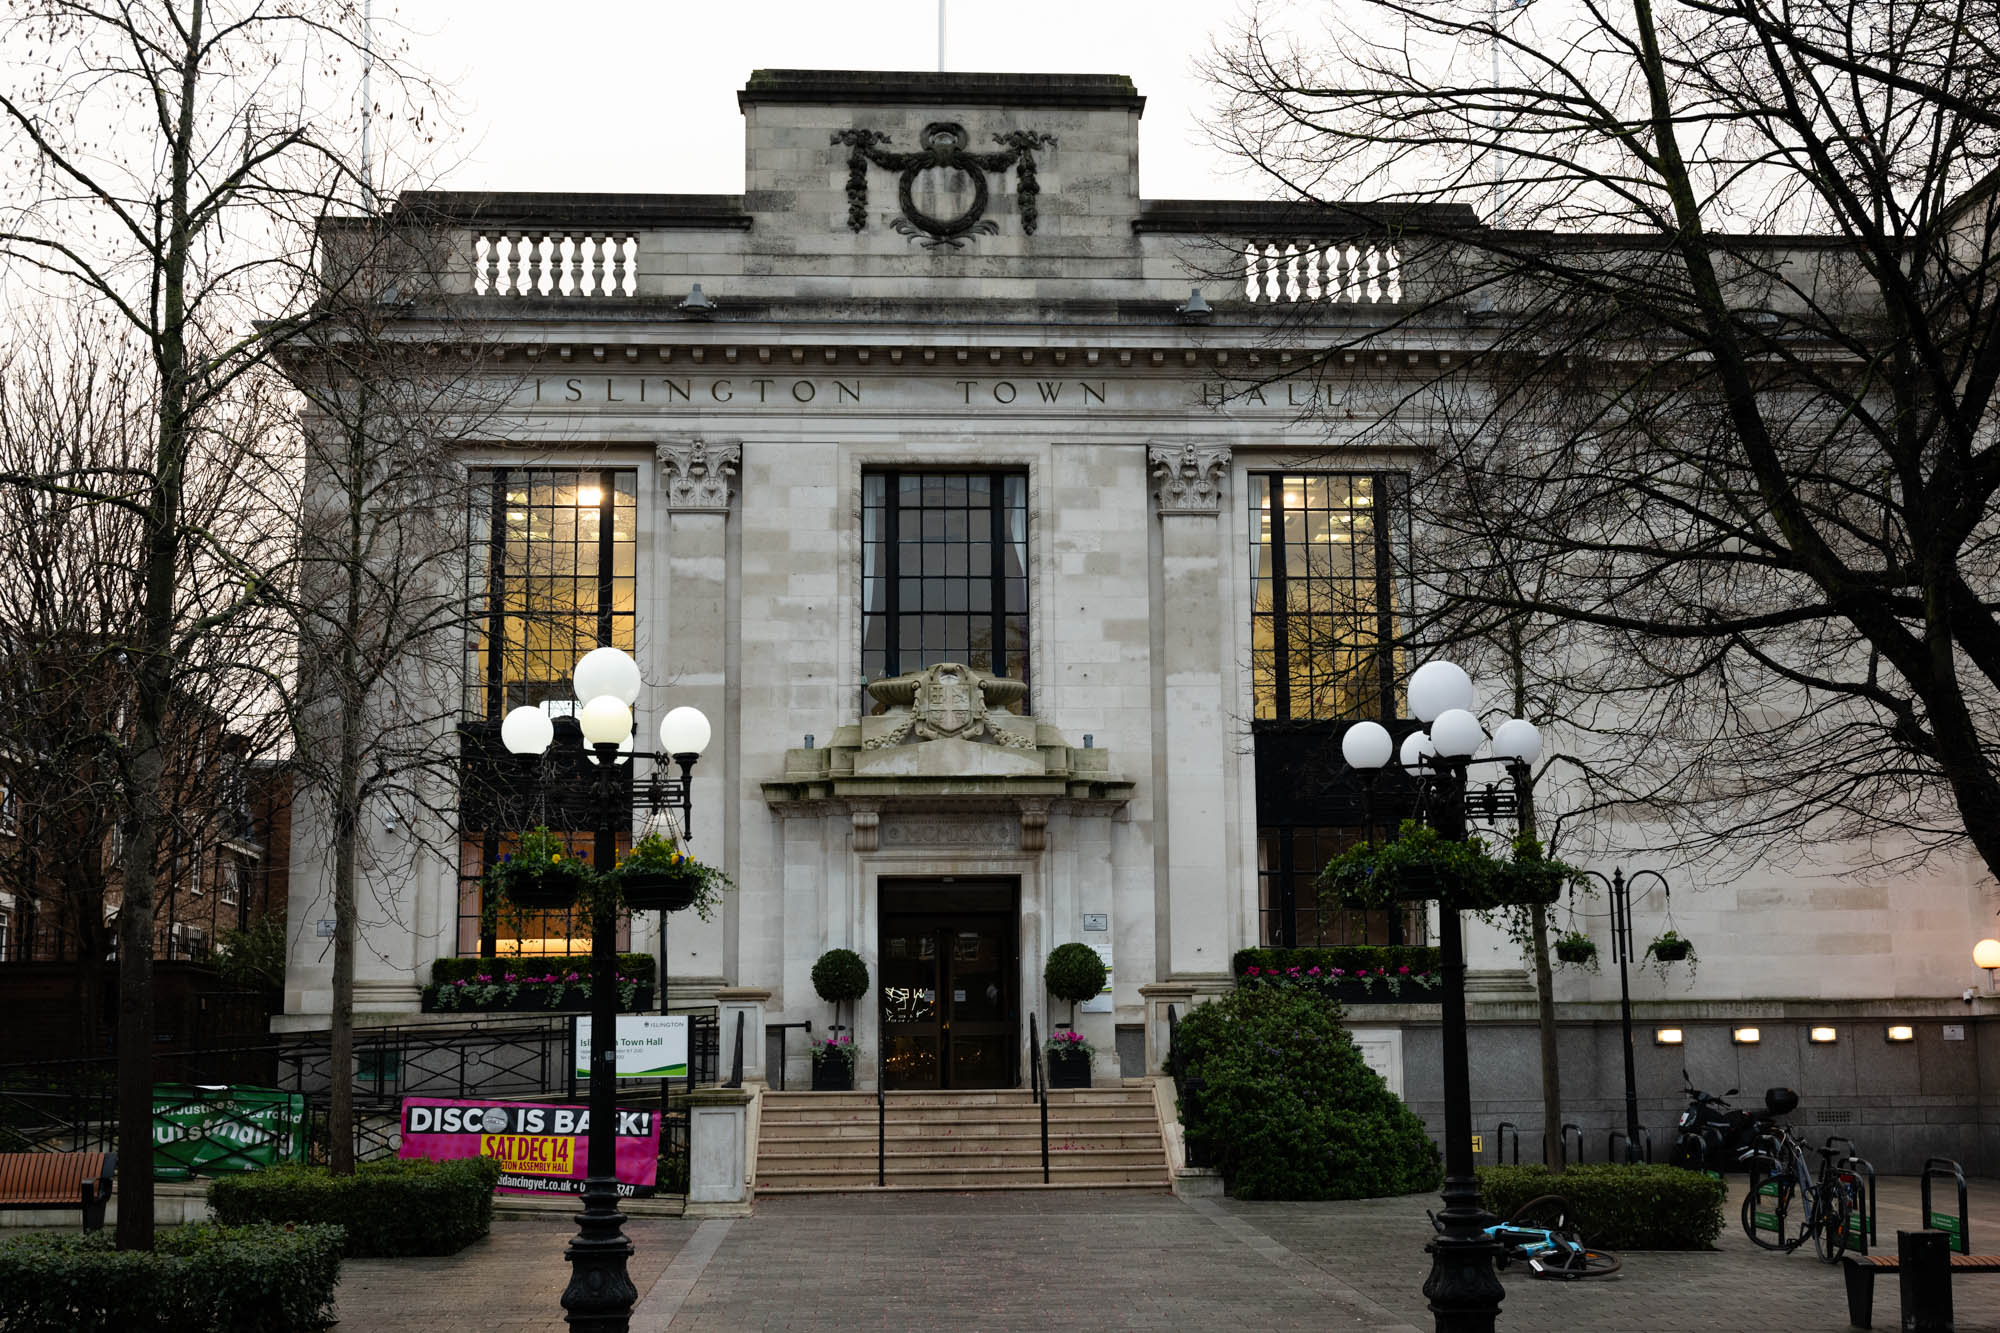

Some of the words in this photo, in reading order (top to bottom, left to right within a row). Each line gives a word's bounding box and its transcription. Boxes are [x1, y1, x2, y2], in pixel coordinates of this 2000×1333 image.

[536, 378, 861, 402] ISLINGTON
[956, 380, 1106, 404] TOWN
[1203, 383, 1343, 406] HALL
[646, 1038, 663, 1046] Hall
[517, 1108, 544, 1133] IS
[554, 1110, 649, 1135] BAK!
[486, 1136, 515, 1160] SAT
[518, 1137, 547, 1162] DEC
[551, 1138, 568, 1163] 14
[519, 1162, 550, 1172] ASSEMBLY
[552, 1163, 568, 1173] HALL
